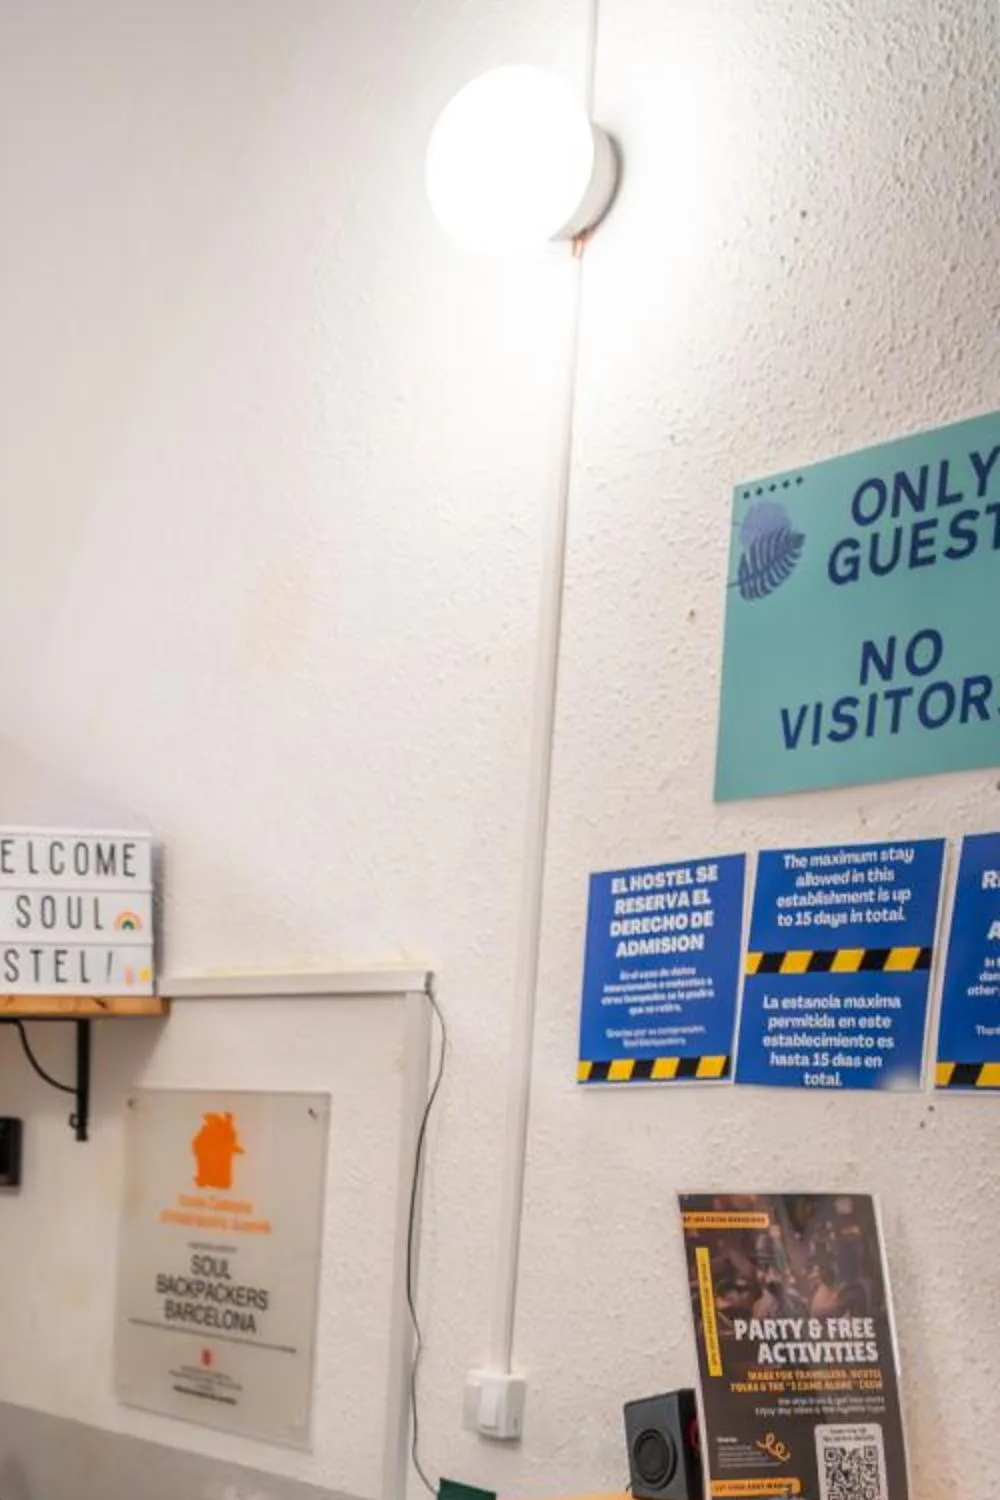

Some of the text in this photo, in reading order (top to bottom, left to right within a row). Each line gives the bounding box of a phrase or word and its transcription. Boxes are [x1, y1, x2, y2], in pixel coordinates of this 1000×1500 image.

[851, 445, 1000, 527] ONLY
[859, 628, 943, 686] NO
[780, 674, 1000, 750] VISITOR
[783, 847, 915, 869] The maximum stay
[611, 864, 718, 895] EL HOSTEL SE
[795, 867, 895, 888] allowed in this
[614, 888, 711, 915] RESERVA EL
[776, 885, 912, 908] establishment is up
[15, 894, 104, 930] SOUL
[610, 910, 714, 937] DERECHO DE
[777, 912, 793, 927] to
[795, 911, 812, 926] 15
[813, 909, 848, 929] days
[849, 908, 863, 924] in
[616, 933, 705, 958] ADMISION
[763, 994, 779, 1009] La
[781, 993, 841, 1009] estancia
[767, 1012, 893, 1033] permitida en este
[762, 1032, 895, 1049] establecimiento es
[769, 1051, 809, 1067] hasta
[812, 1051, 829, 1067] 15
[864, 1055, 883, 1068] en
[190, 1254, 231, 1280] SOUL
[155, 1273, 270, 1311] BACKPACKERS
[164, 1299, 257, 1333] BARCELONA
[734, 1317, 876, 1341] PARTY & FREE
[757, 1341, 879, 1364] ACTIVITIES
